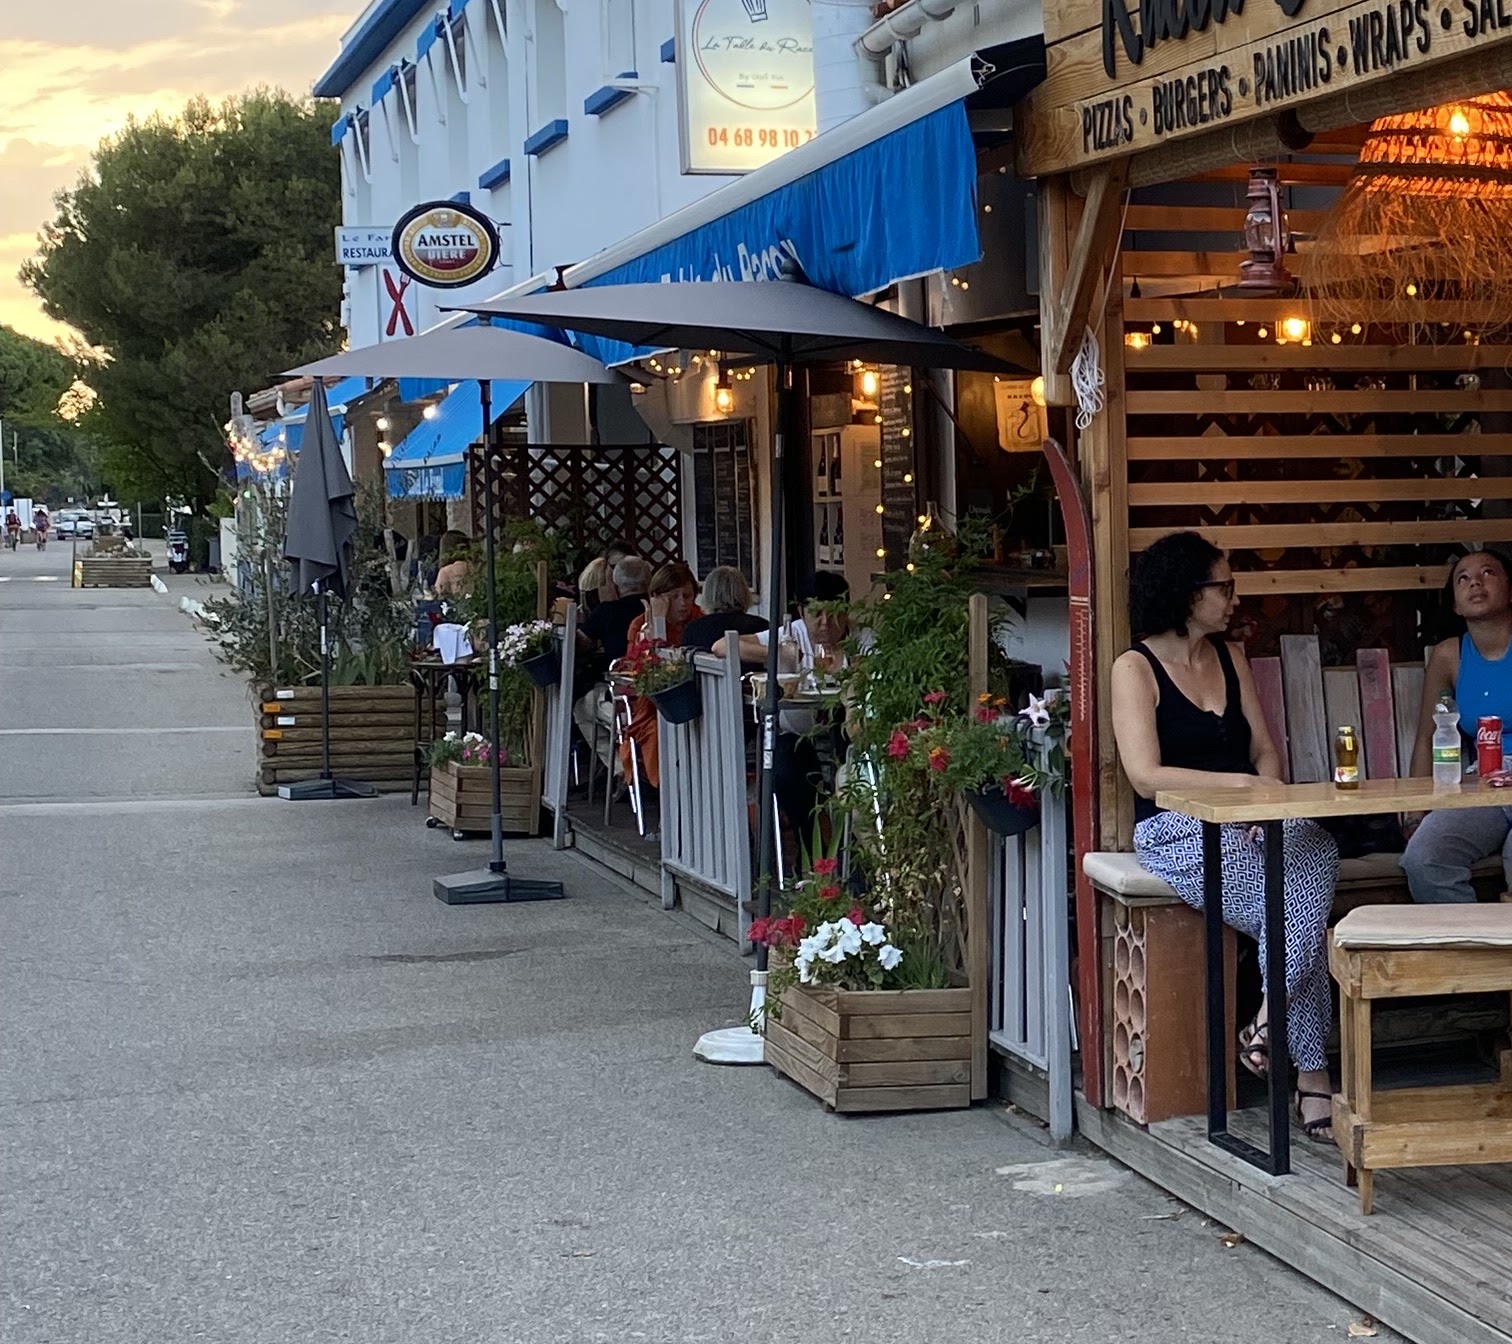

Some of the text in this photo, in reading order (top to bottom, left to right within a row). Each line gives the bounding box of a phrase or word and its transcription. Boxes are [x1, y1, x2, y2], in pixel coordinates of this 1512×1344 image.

[777, 37, 813, 54] Raco
[1081, 94, 1134, 154] PIZZAS
[1151, 65, 1232, 136] BURGERS
[1253, 27, 1333, 105] PANINIS
[707, 127, 799, 148] 04 68 98 10
[341, 234, 359, 243] Le
[417, 234, 476, 248] AMSTEL
